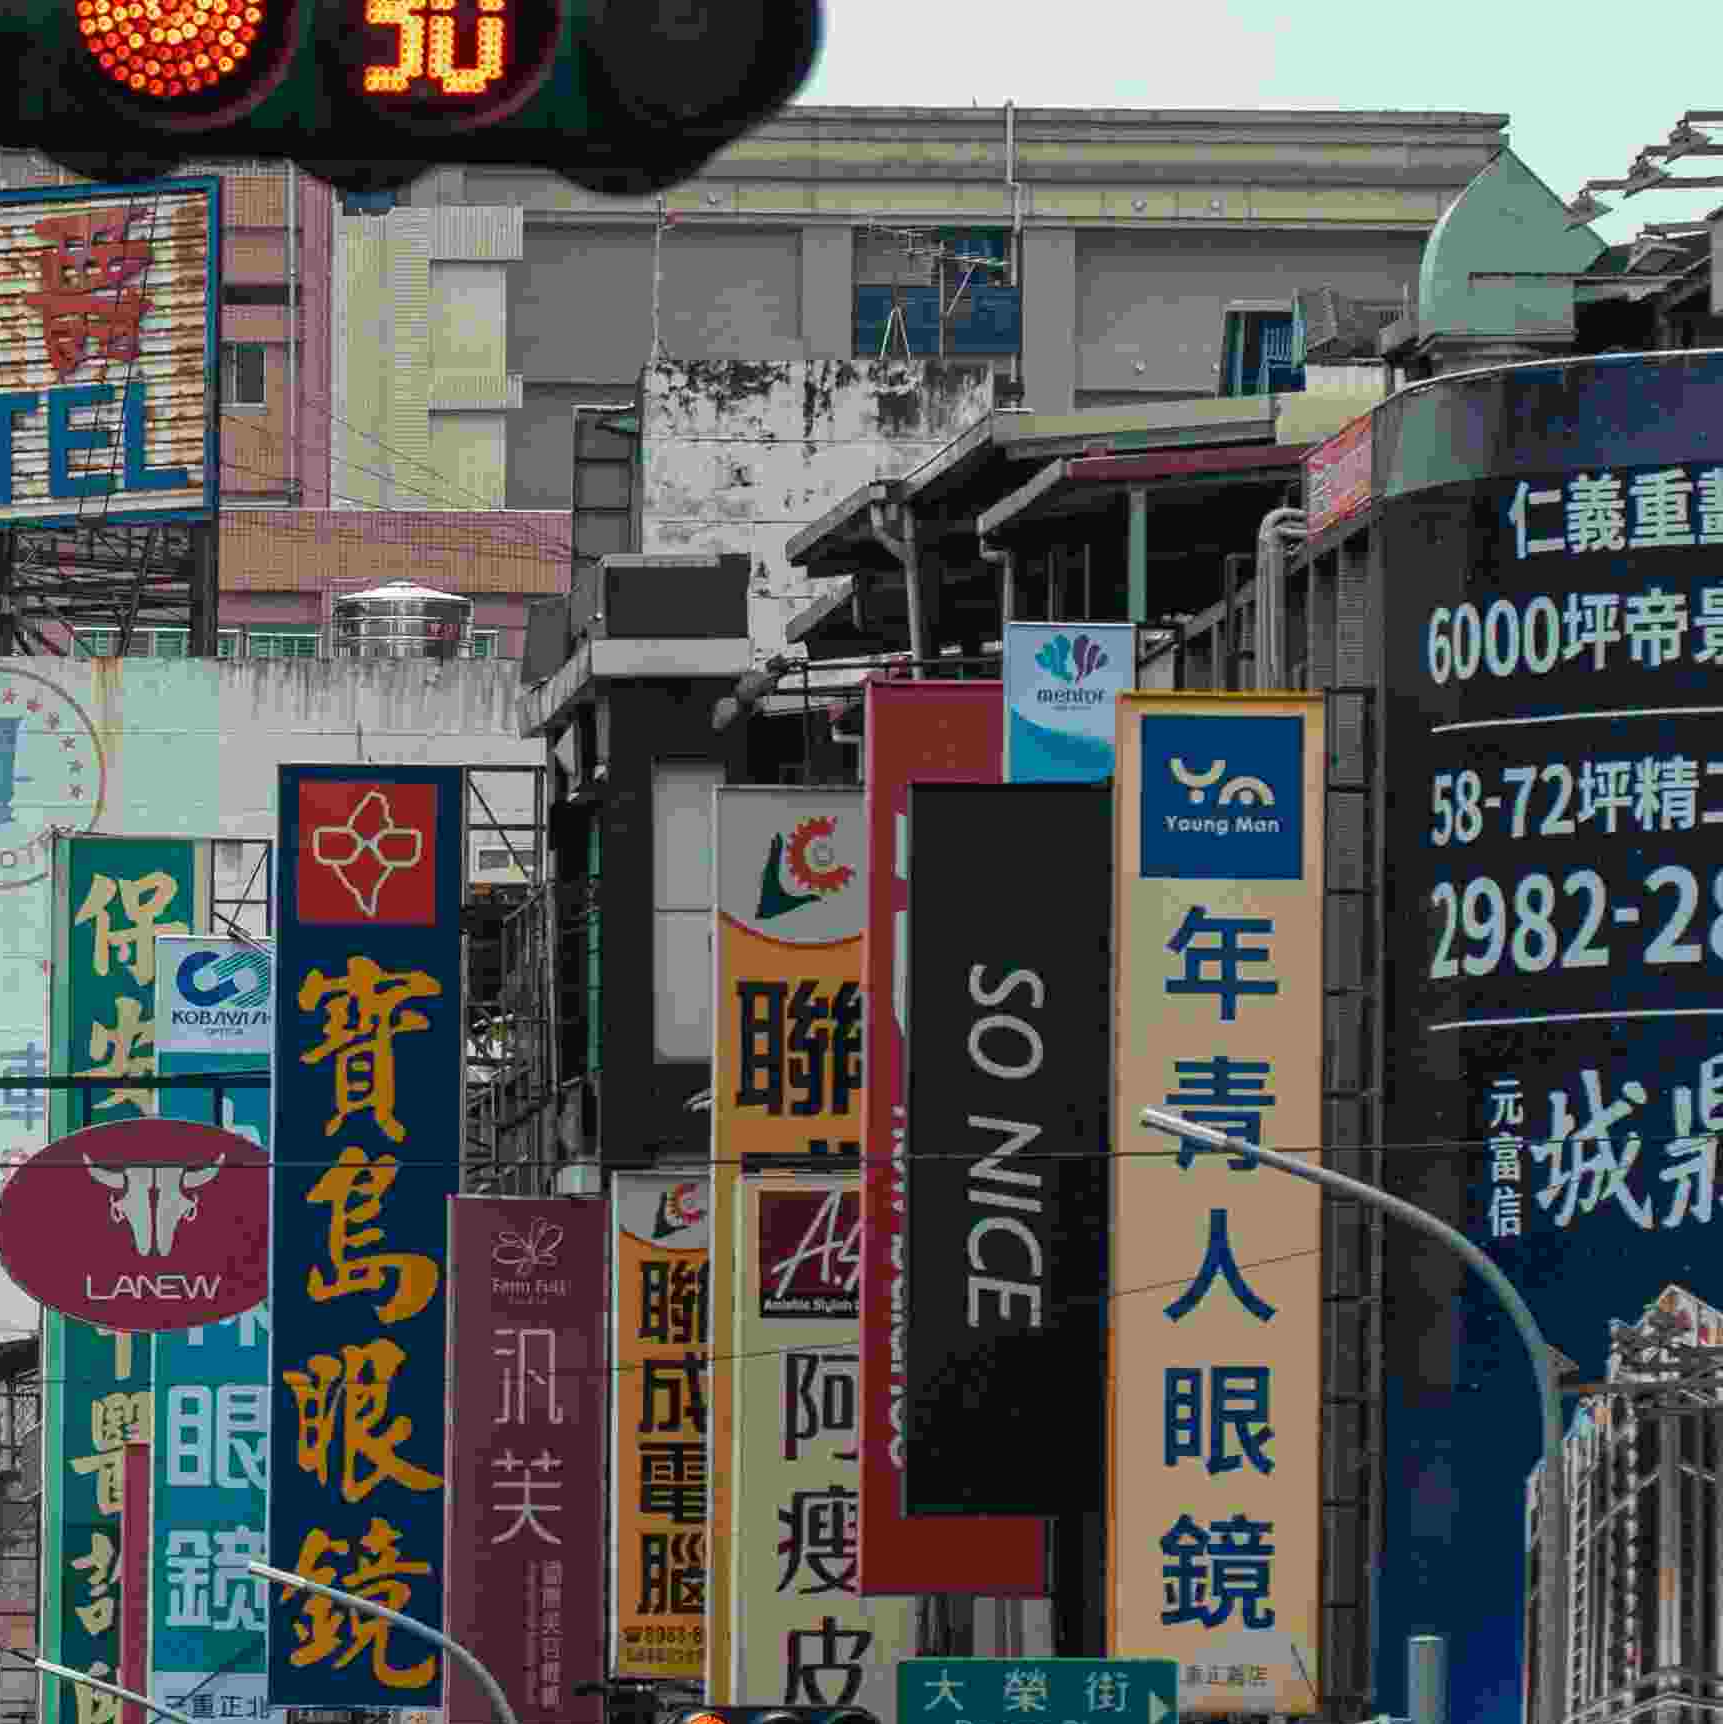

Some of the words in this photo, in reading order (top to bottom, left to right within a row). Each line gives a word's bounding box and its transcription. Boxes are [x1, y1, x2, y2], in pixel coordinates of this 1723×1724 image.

[1163, 815, 1229, 836] Young
[1234, 816, 1281, 834] Man
[966, 964, 1044, 1079] SO
[966, 1112, 1044, 1328] NICE
[1159, 904, 1279, 1632] 年青人眼鏡
[282, 955, 445, 1689] 寶島眼鏡
[924, 1670, 1131, 1713] 大榮街
